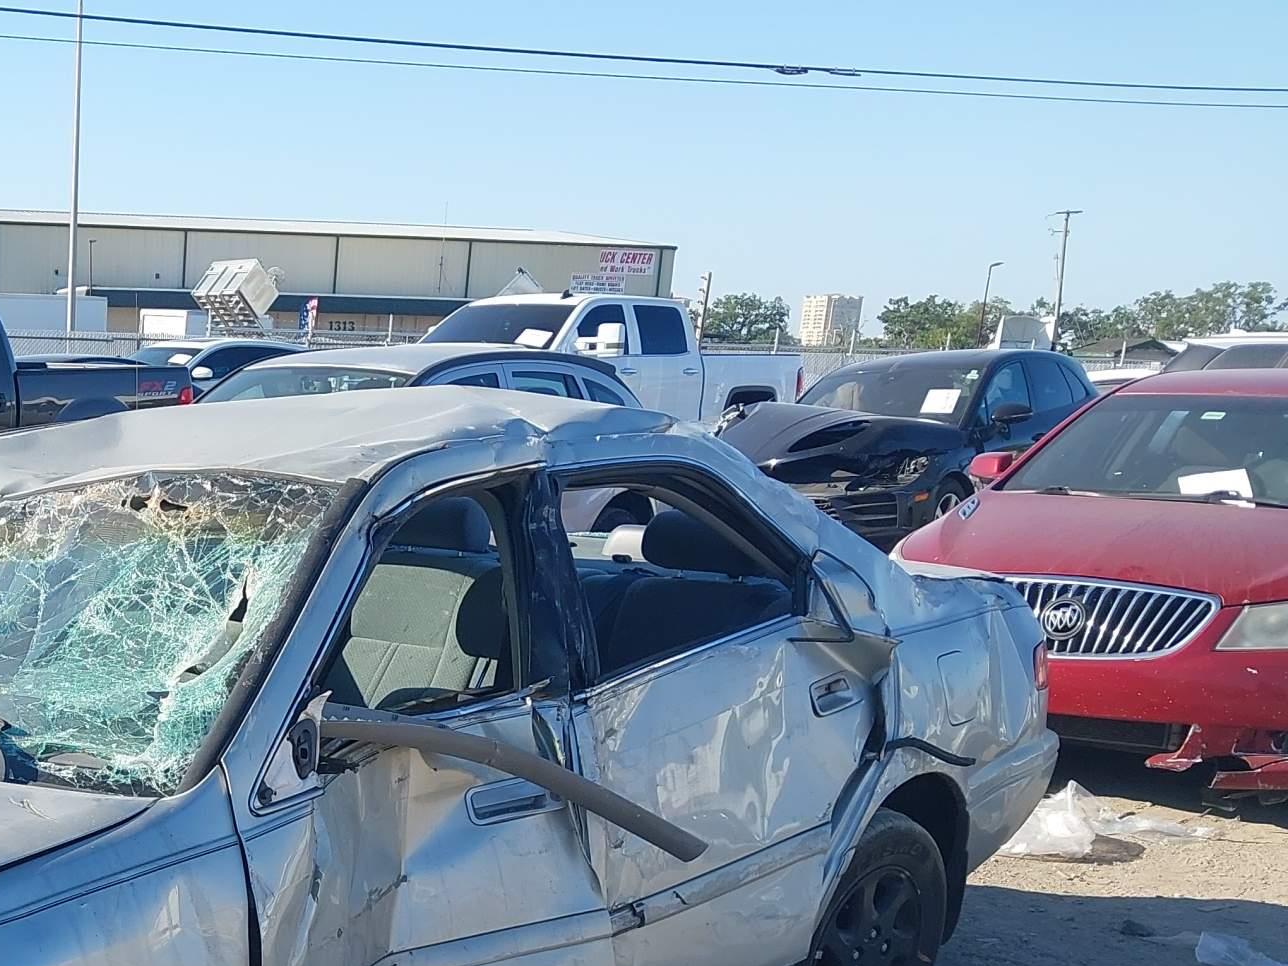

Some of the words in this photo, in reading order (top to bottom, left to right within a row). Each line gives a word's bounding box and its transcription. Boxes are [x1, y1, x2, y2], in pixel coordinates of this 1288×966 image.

[620, 252, 654, 265] CENTER
[610, 265, 625, 273] Work
[328, 320, 355, 332] 1313
